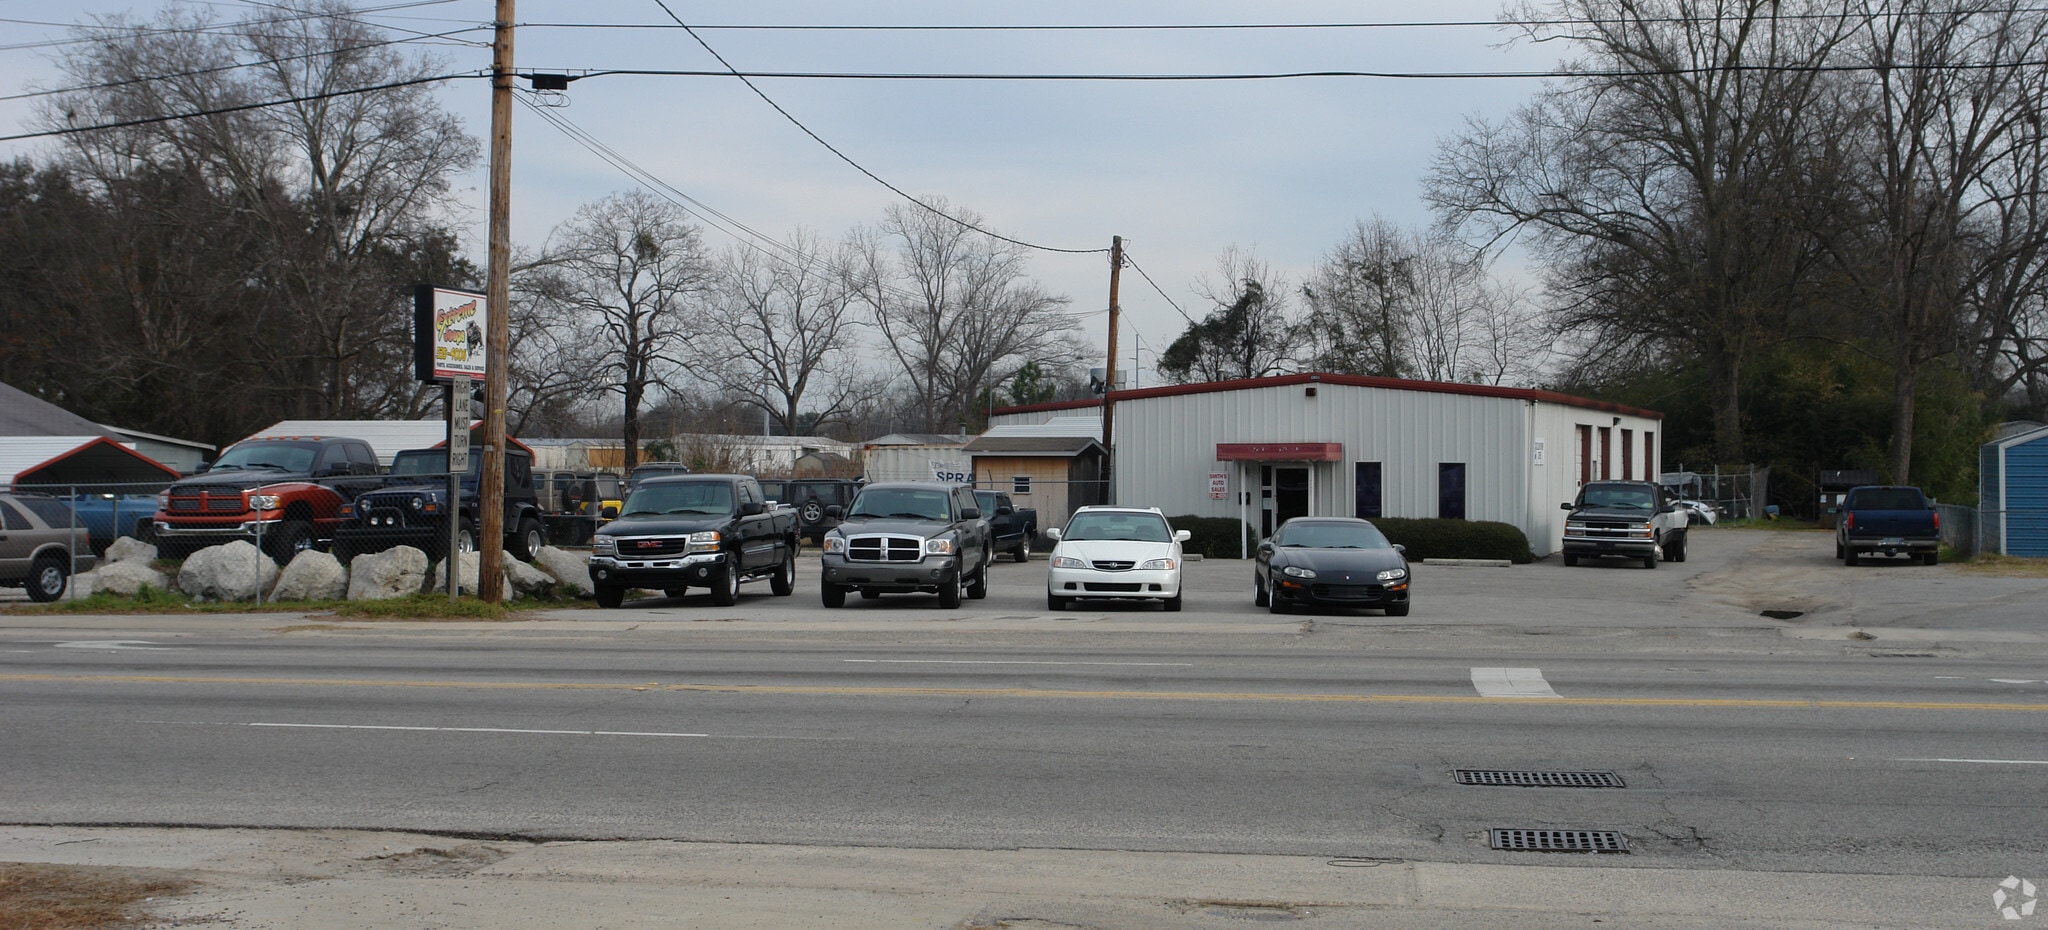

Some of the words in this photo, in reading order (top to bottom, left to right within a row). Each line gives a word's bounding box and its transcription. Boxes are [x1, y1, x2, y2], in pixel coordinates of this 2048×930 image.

[436, 299, 477, 341] Extreme
[455, 380, 469, 394] RIGHT
[455, 399, 469, 412] LANE
[454, 417, 468, 430] MUST
[454, 434, 468, 448] TURN
[452, 452, 468, 466] RIGHT
[636, 540, 663, 549] GMC
